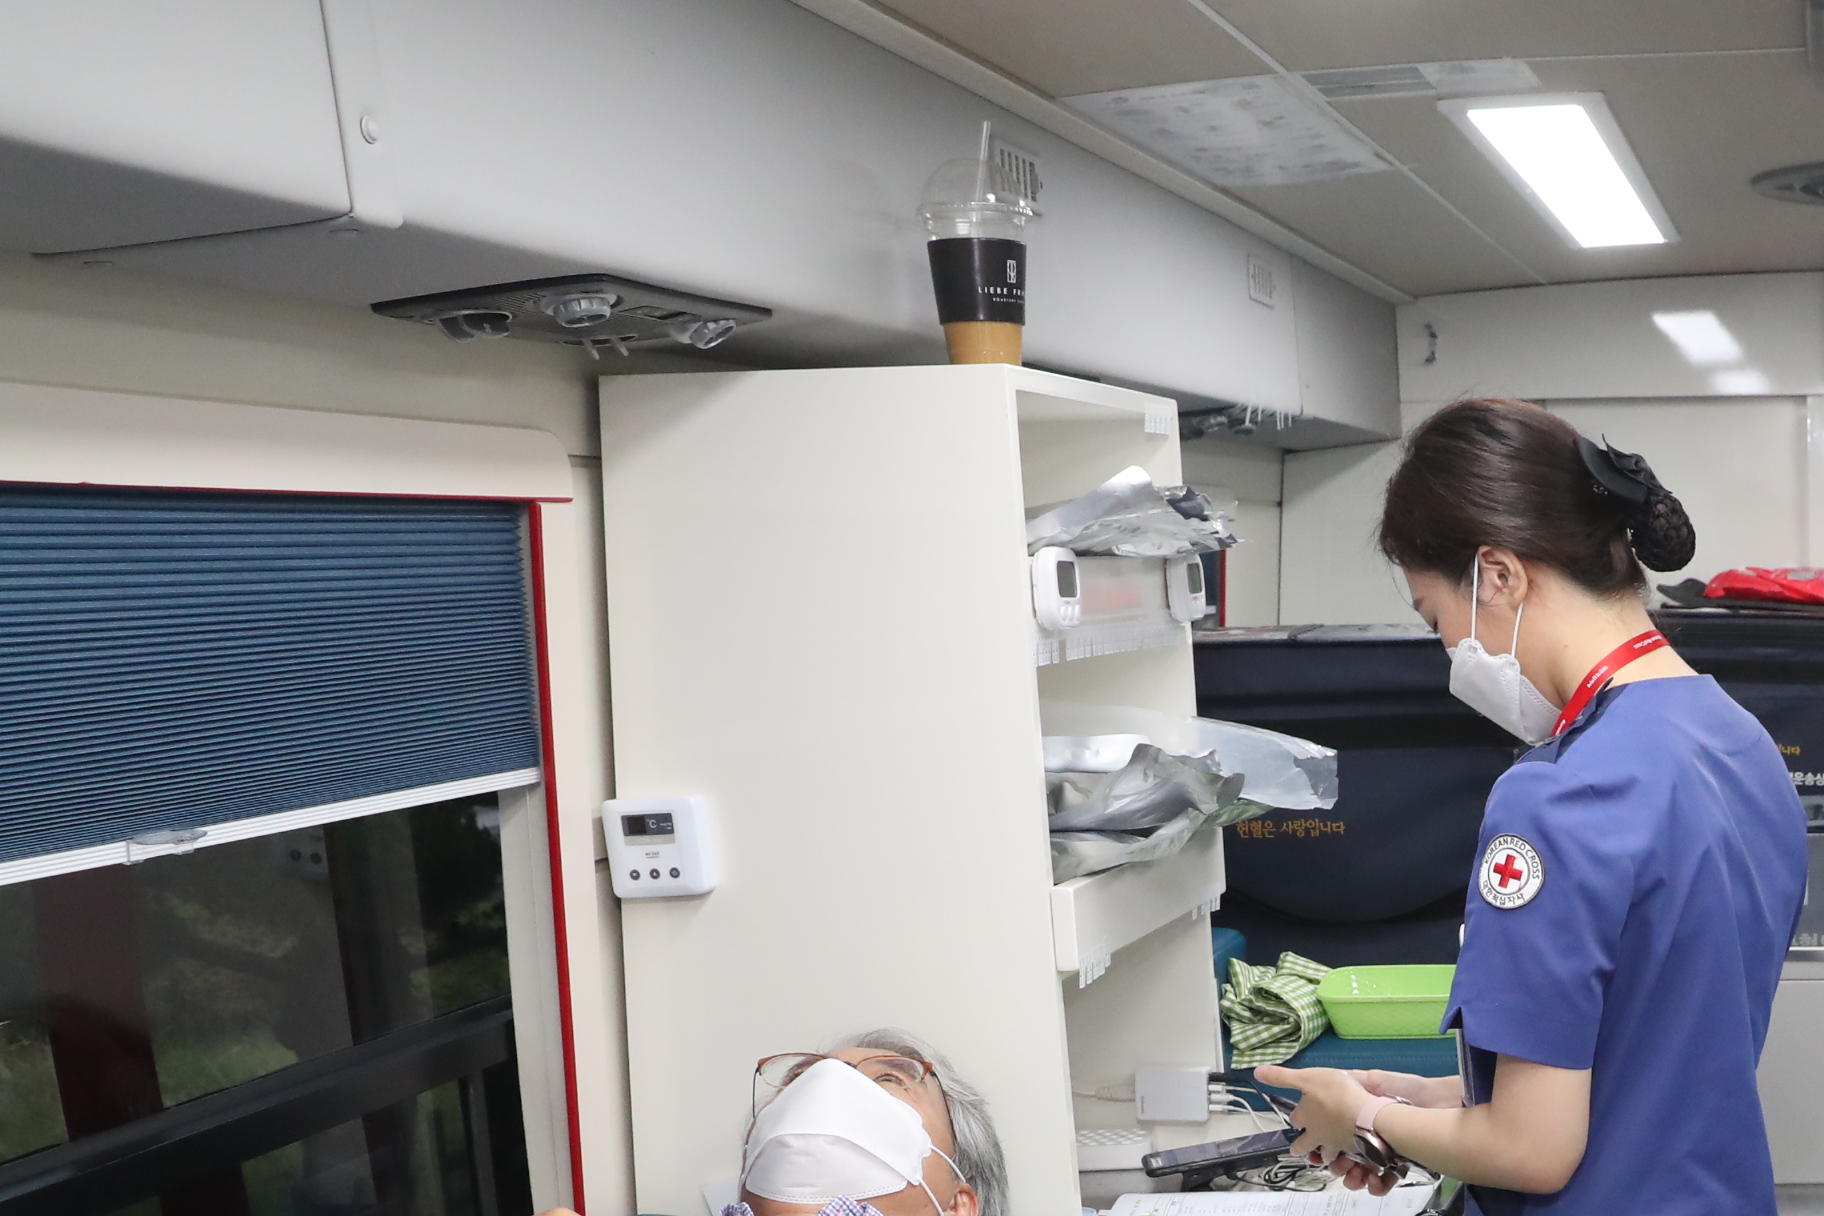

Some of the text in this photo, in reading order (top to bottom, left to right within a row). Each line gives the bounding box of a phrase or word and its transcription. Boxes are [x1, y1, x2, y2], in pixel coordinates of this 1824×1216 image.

[978, 286, 1008, 295] LIEBE
[1237, 819, 1346, 838] 헌혈은 사랑입니다
[1484, 837, 1540, 880] KOREAN RED CROSS
[1483, 880, 1525, 906] 대한적십자사
